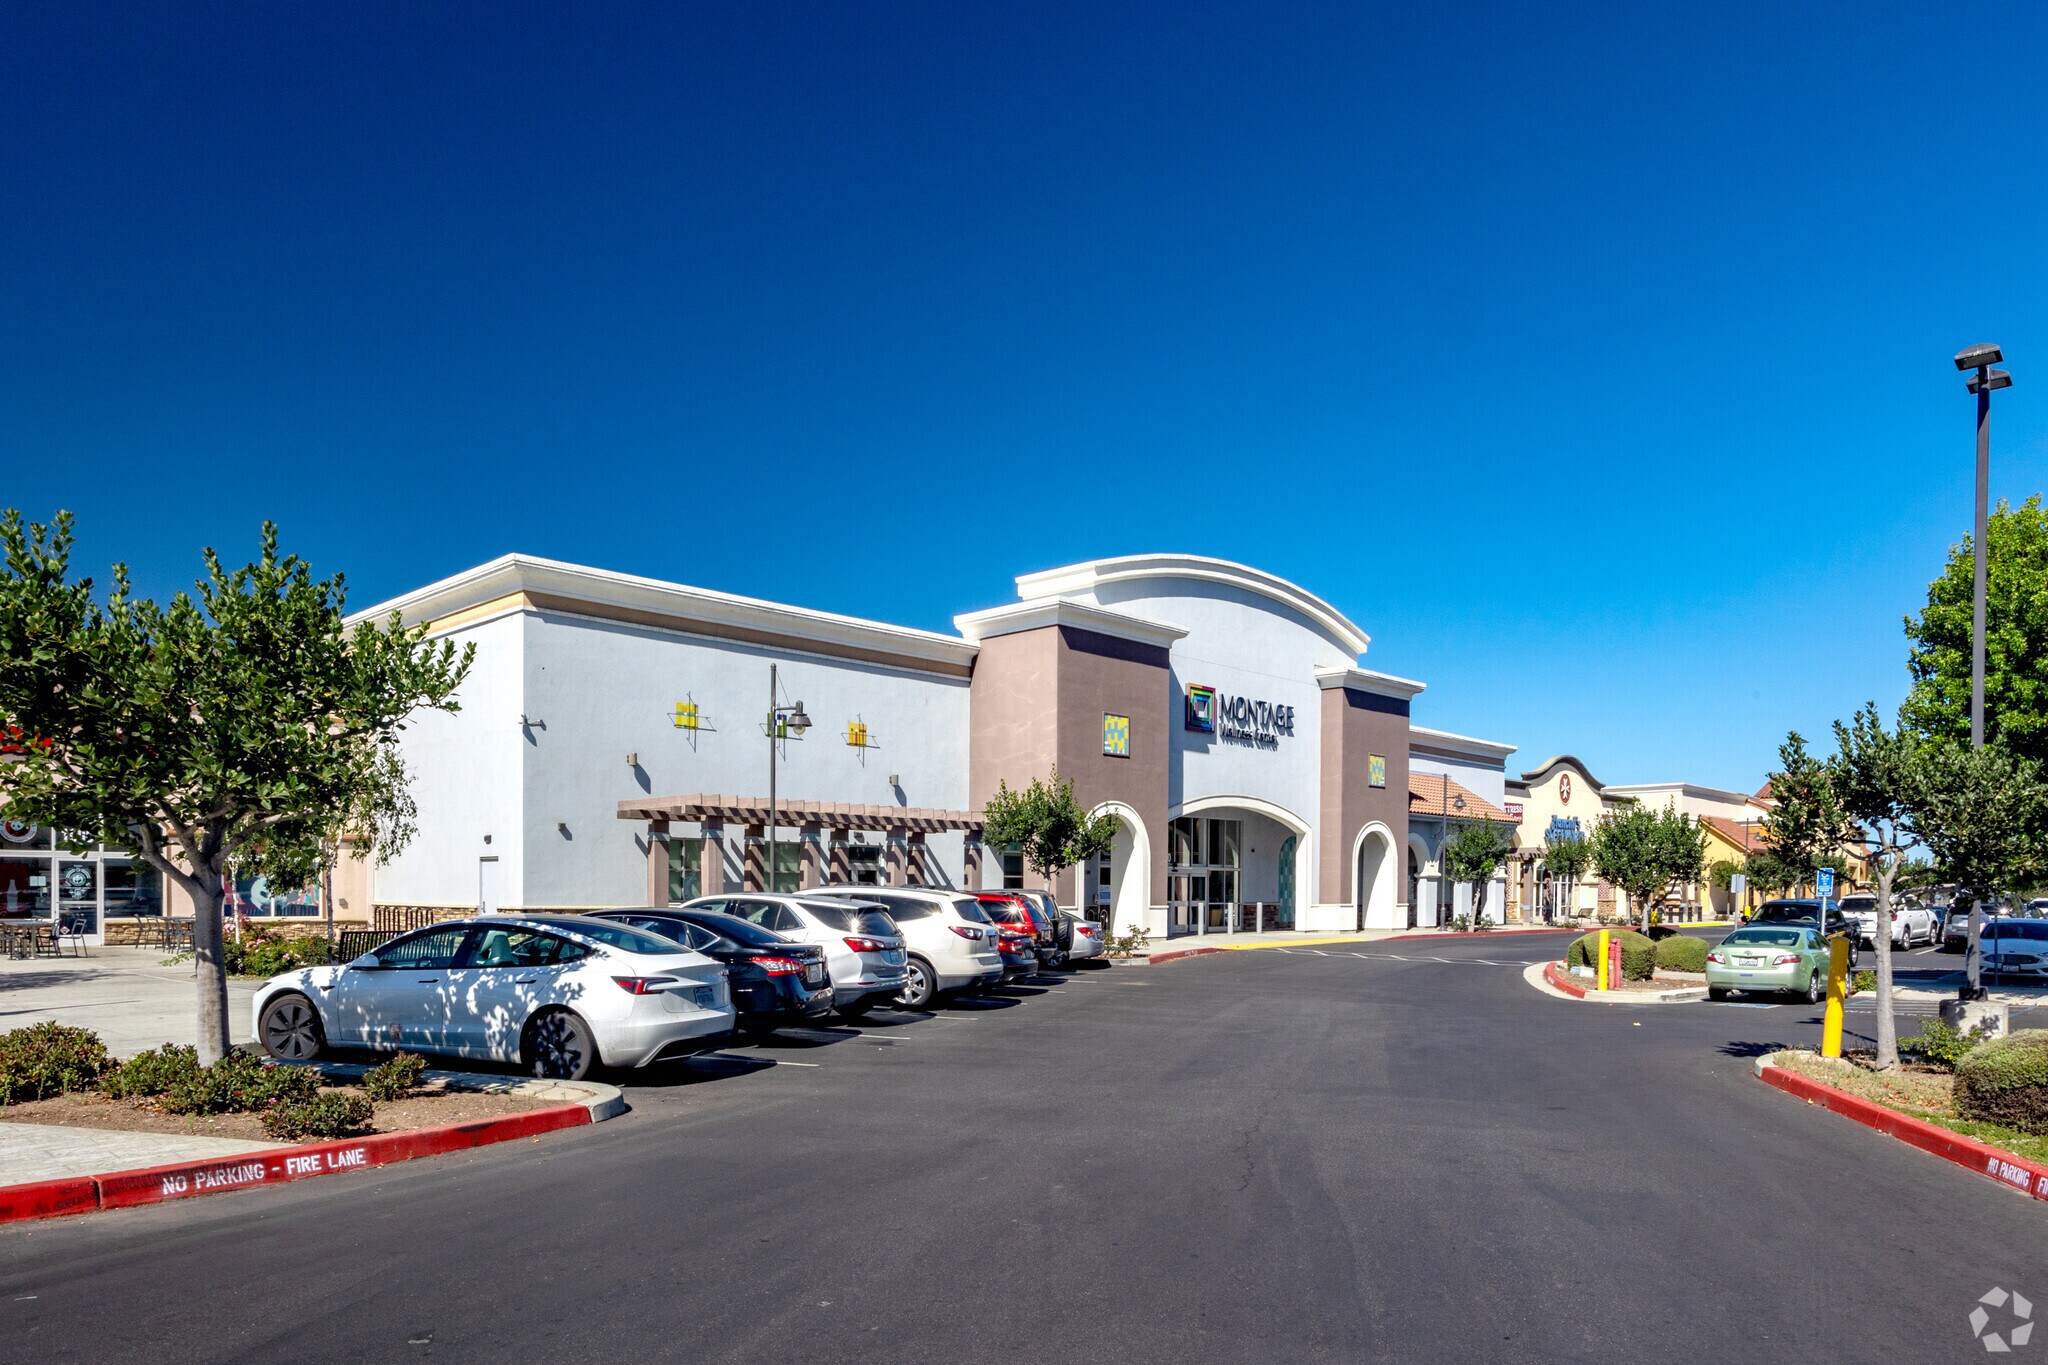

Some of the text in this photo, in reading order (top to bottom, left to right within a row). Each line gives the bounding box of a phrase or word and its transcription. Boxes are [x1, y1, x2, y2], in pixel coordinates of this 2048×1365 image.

[1219, 693, 1294, 729] MONTAGE
[162, 1174, 188, 1196] NO
[196, 1163, 264, 1189] PARKING
[286, 1154, 322, 1175] FIRE
[328, 1149, 366, 1168] LANE
[1988, 1157, 1999, 1174] NO
[2000, 1162, 2030, 1187] PARKING
